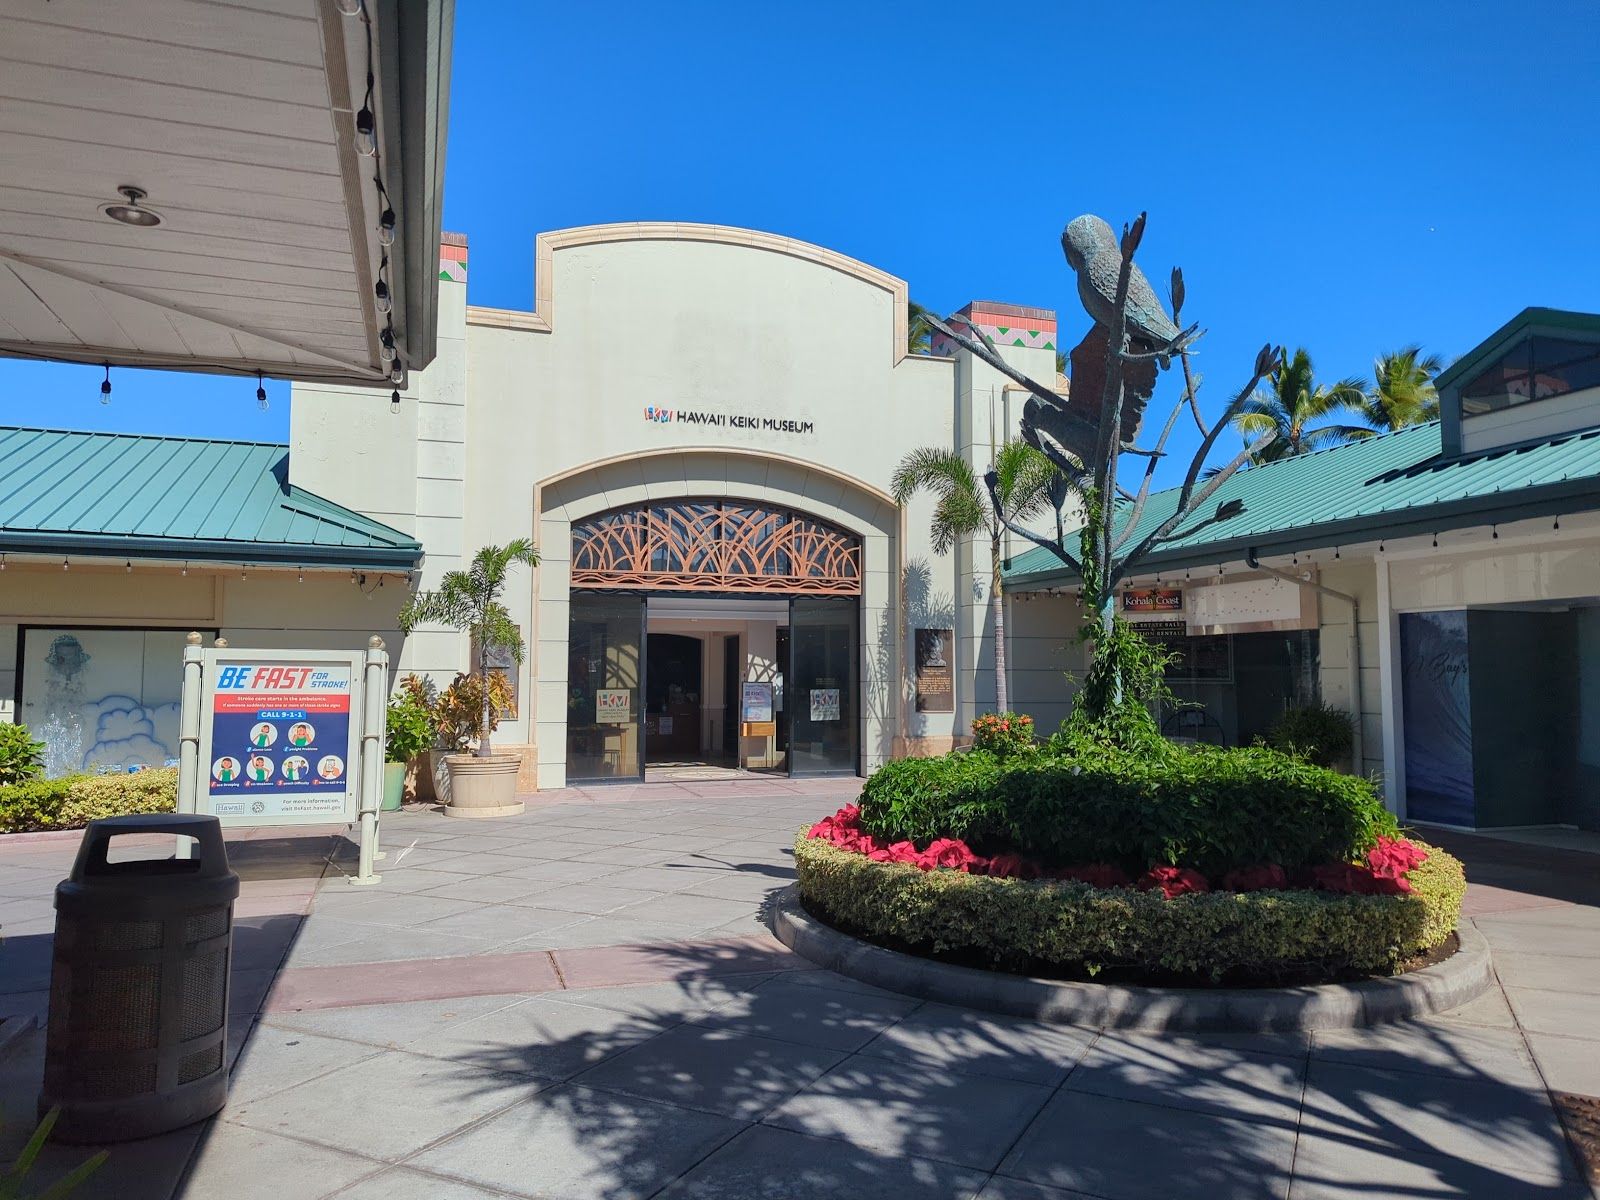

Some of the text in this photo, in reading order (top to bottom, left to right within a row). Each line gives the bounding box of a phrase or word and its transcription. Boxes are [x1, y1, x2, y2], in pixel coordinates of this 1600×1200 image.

[677, 410, 814, 434] HAWAI'I KEIKI MUSEUM
[1125, 595, 1179, 606] Kohala Coast
[217, 667, 314, 689] BE FAST
[311, 672, 329, 680] FOR
[310, 680, 348, 689] STROKE!
